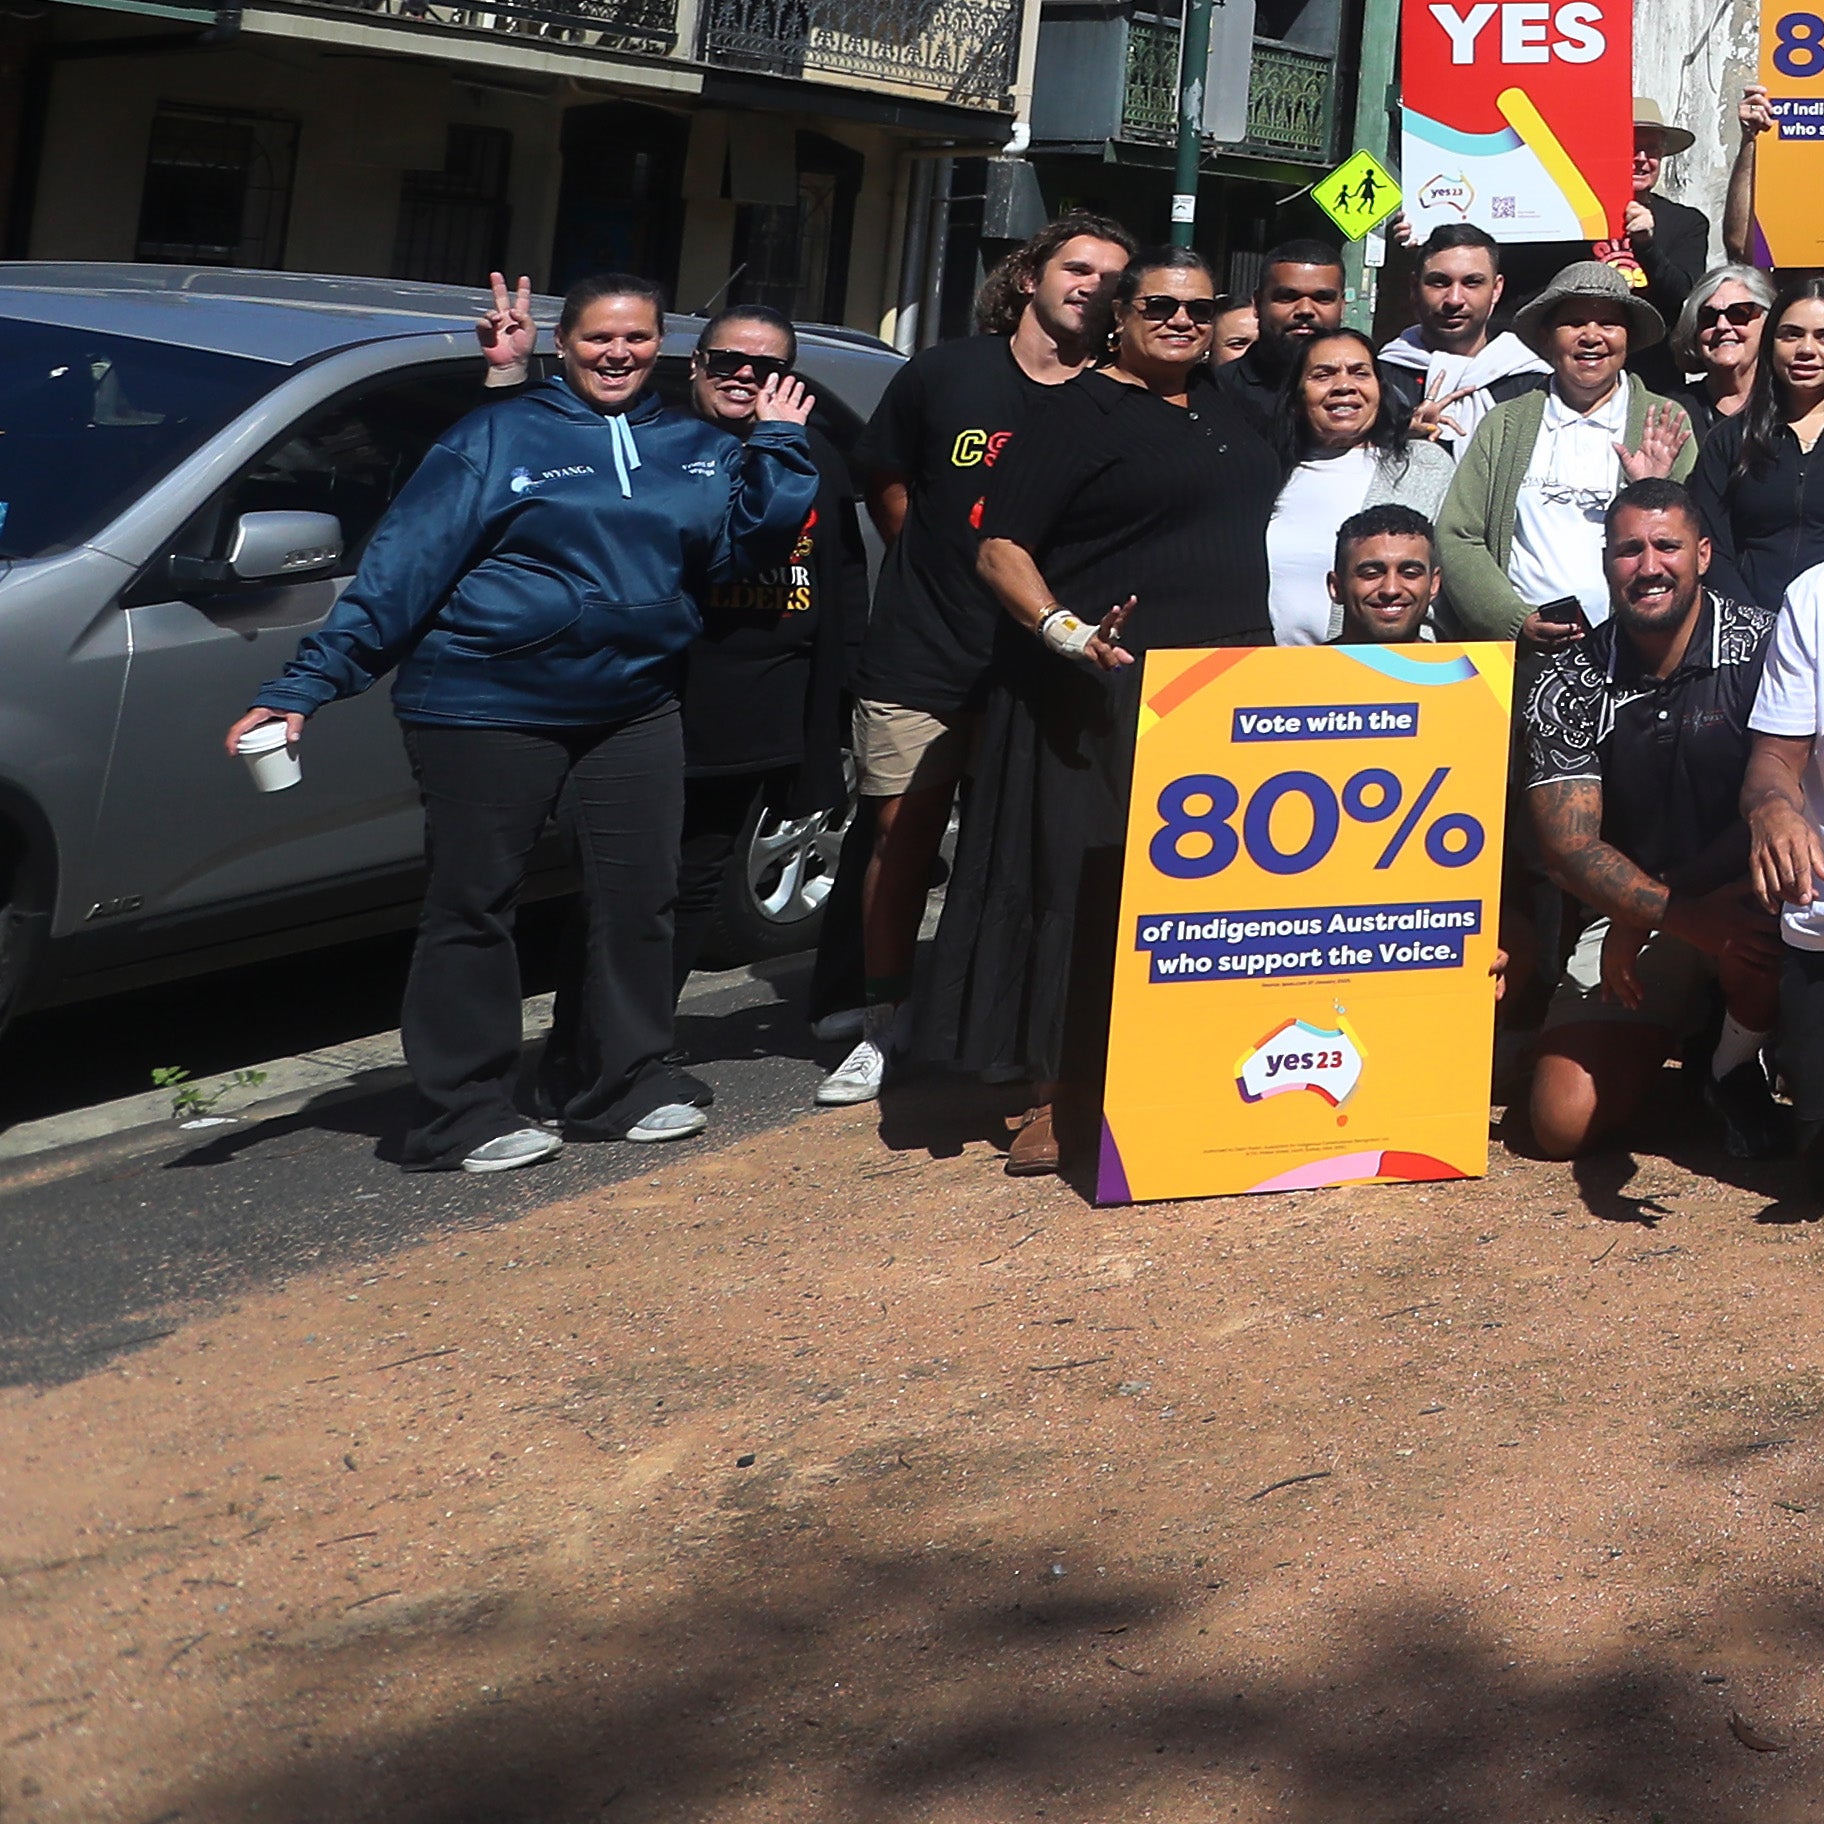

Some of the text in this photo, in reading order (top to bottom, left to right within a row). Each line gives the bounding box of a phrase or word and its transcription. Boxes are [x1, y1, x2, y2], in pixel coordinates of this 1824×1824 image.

[1429, 2, 1605, 64] YES
[1773, 101, 1790, 116] of
[1782, 122, 1812, 137] who
[1239, 710, 1412, 734] Vote with the
[1149, 768, 1485, 879] 80%
[1142, 909, 1475, 943] of Indigenous Australians
[1157, 941, 1458, 975] who support the Voice.
[1266, 1051, 1342, 1077] yes23
